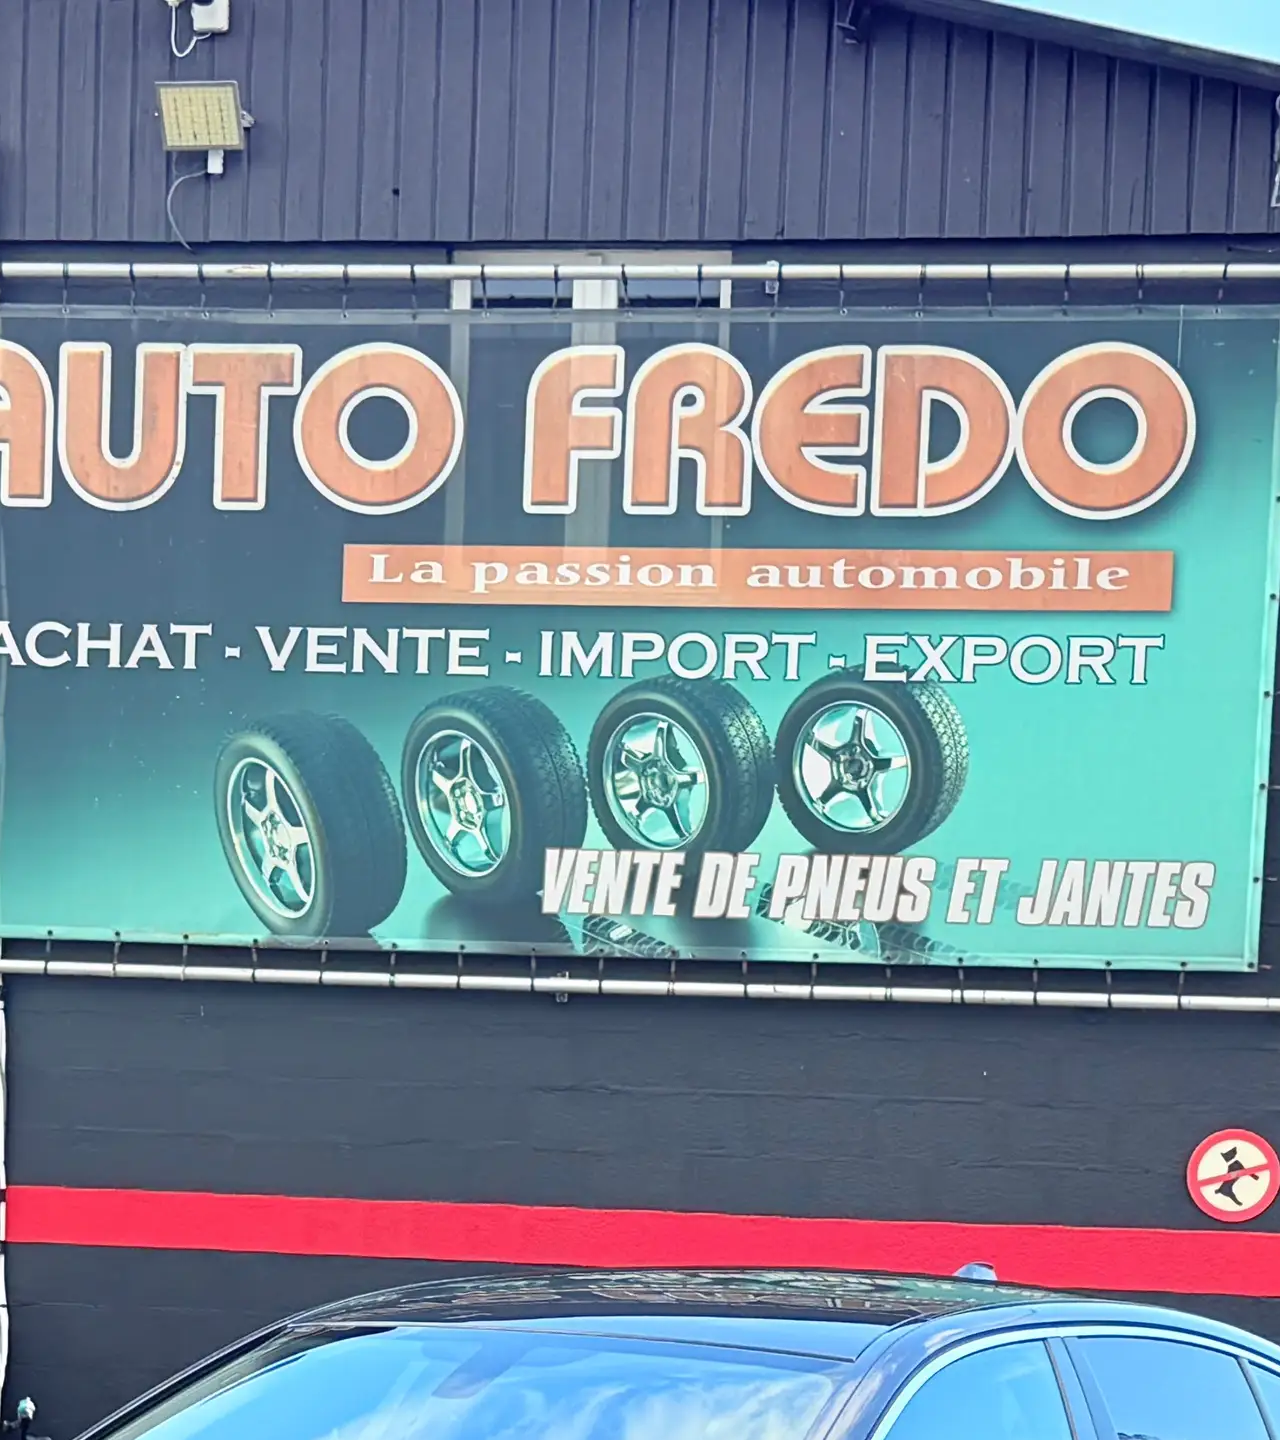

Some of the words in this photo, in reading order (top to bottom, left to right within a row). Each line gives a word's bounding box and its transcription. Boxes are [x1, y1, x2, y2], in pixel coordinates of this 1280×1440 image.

[523, 341, 1197, 521] FREDO
[369, 553, 447, 584] La
[469, 554, 717, 594] passion
[746, 556, 1130, 592] automobile
[255, 624, 490, 677] VENTE
[537, 629, 816, 681] IMPORT
[863, 632, 1165, 686] EXPORT
[541, 847, 686, 917] VENTE
[692, 851, 761, 919] DE
[768, 853, 937, 924] PNEUS
[944, 856, 1011, 925] ET
[1016, 858, 1217, 930] JANTES
